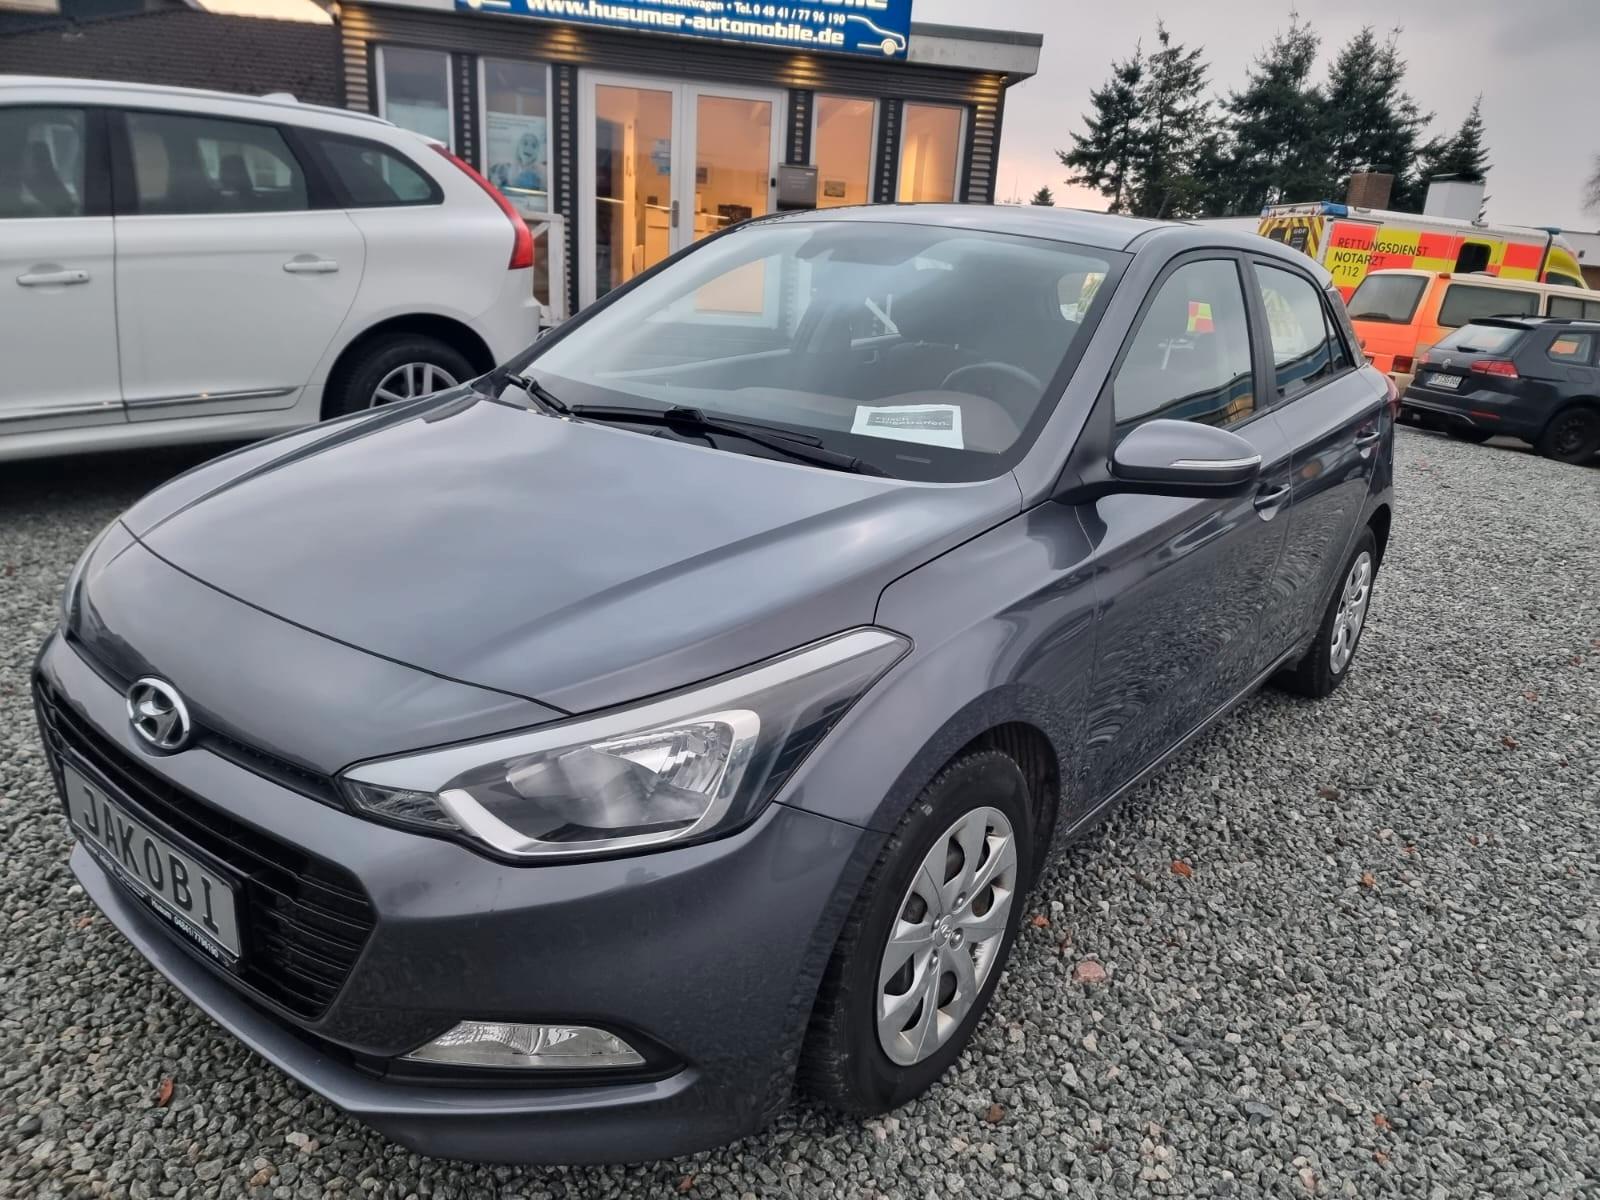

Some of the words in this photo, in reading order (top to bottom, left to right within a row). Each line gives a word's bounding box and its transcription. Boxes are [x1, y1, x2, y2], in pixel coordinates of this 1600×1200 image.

[526, 0, 845, 46] www.husumer-automobile.de
[734, 2, 753, 15] Tel.
[754, 4, 761, 16] 0
[762, 5, 775, 17] 48
[777, 7, 789, 19] 41
[798, 9, 810, 21] 77
[812, 11, 825, 23] 96
[828, 13, 846, 25] 190
[1337, 237, 1429, 257] RETTUNGSDIENST
[1333, 251, 1386, 266] NOTARZT
[1342, 265, 1359, 277] 112
[82, 785, 219, 936] JAKOBI
